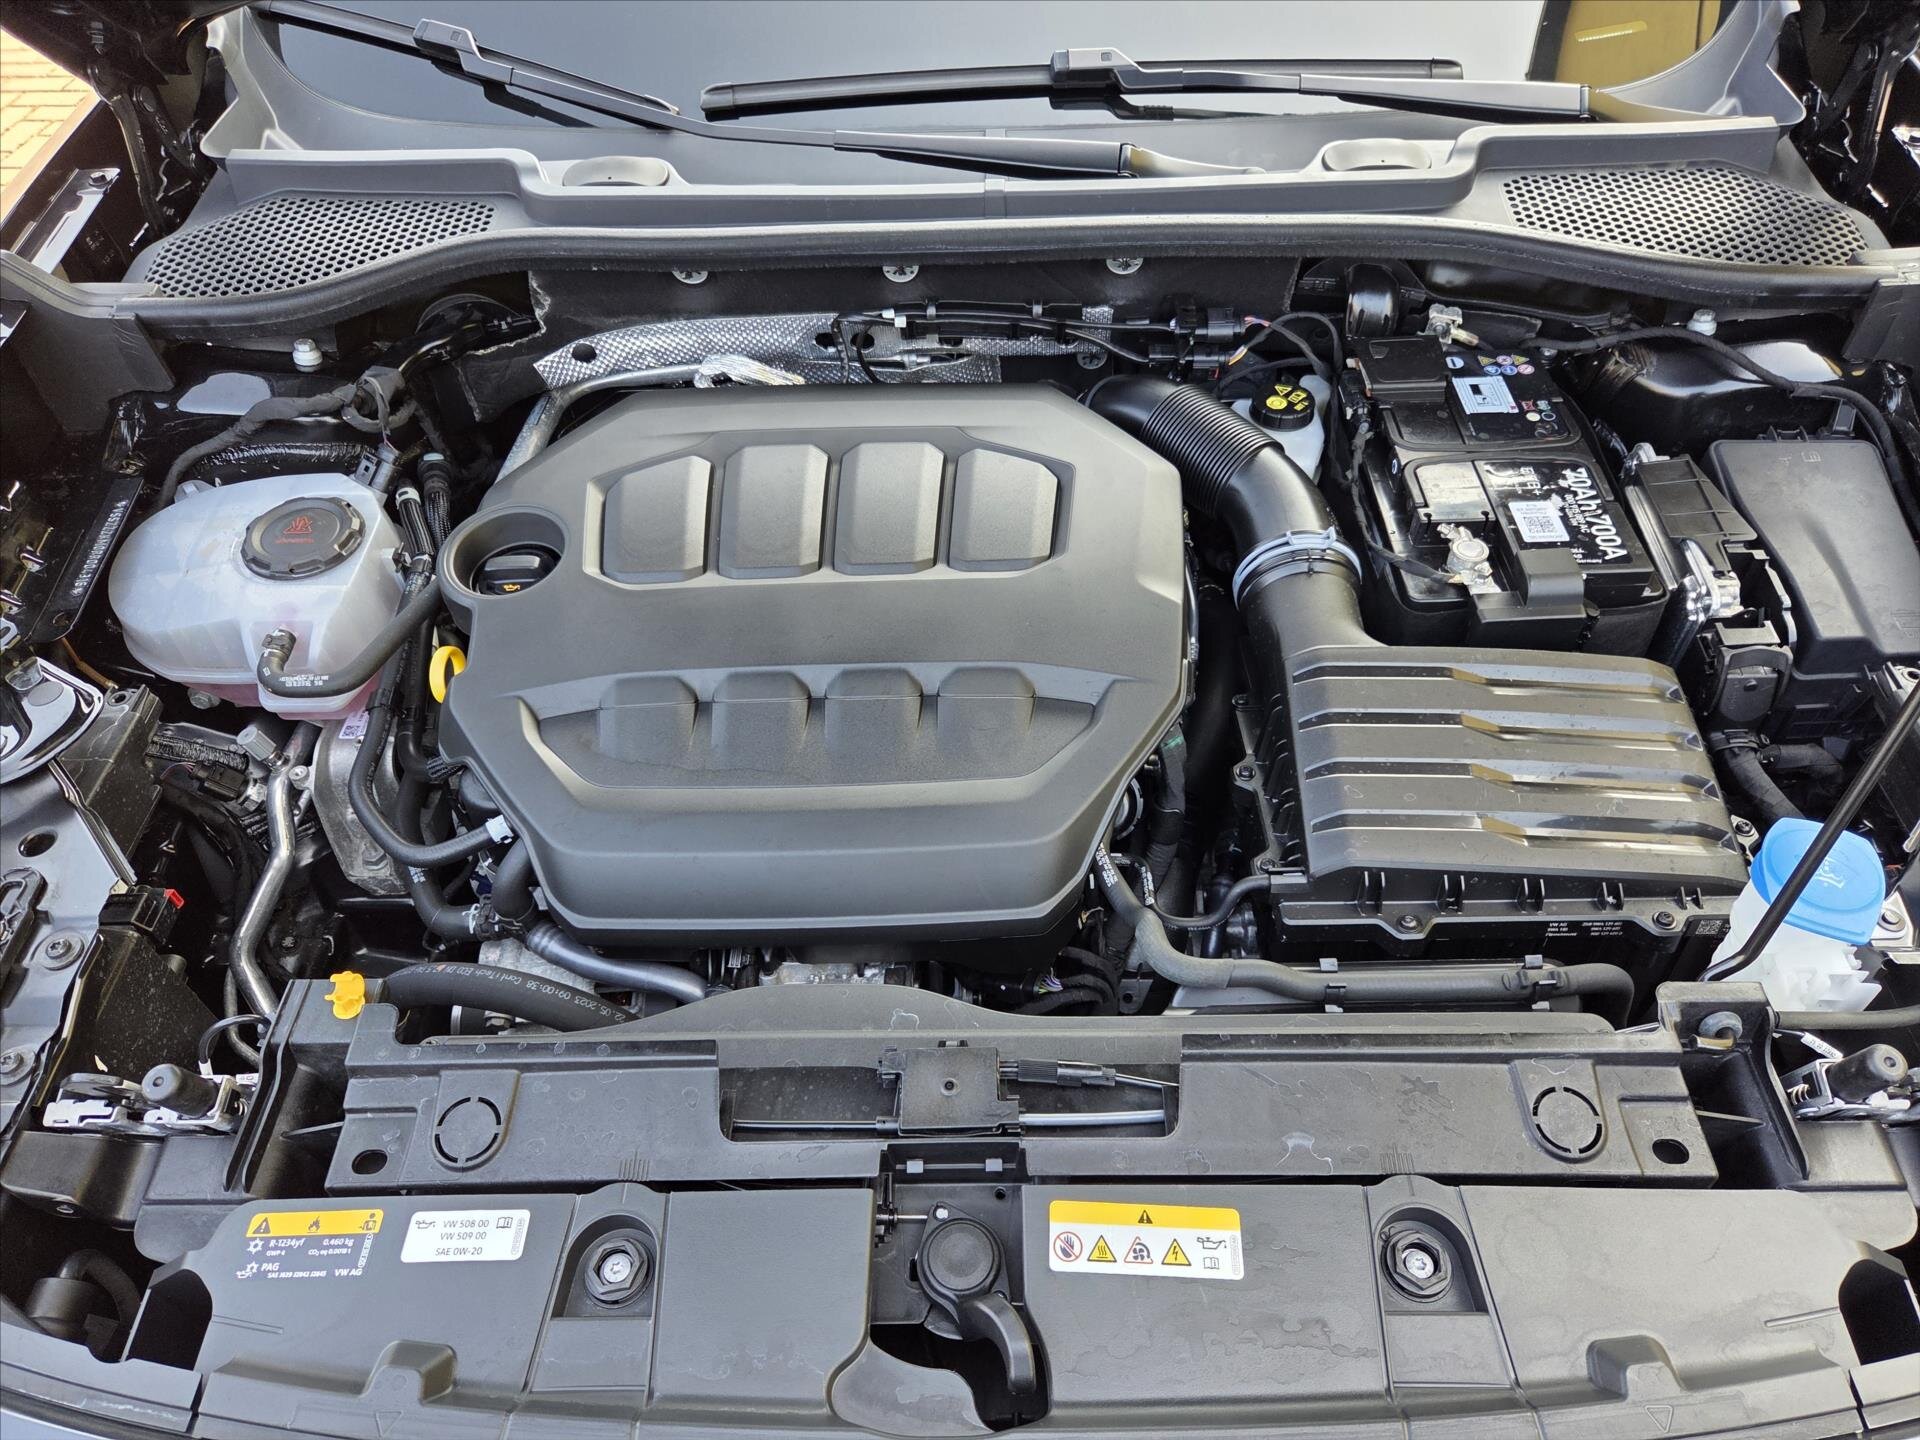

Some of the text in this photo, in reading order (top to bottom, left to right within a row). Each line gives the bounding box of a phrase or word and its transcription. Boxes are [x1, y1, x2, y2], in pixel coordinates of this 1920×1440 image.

[1586, 514, 1627, 559] 700A
[526, 979, 571, 1000] 09:00:38
[443, 1220, 489, 1228] VW 508 00
[457, 1232, 473, 1240] 509
[475, 1232, 487, 1240] 00
[269, 1238, 305, 1248] R-1234yf
[344, 1238, 354, 1247] kg
[435, 1247, 482, 1256] SAE 0W-20
[261, 1263, 280, 1271] PAG
[349, 1268, 362, 1276] AG
